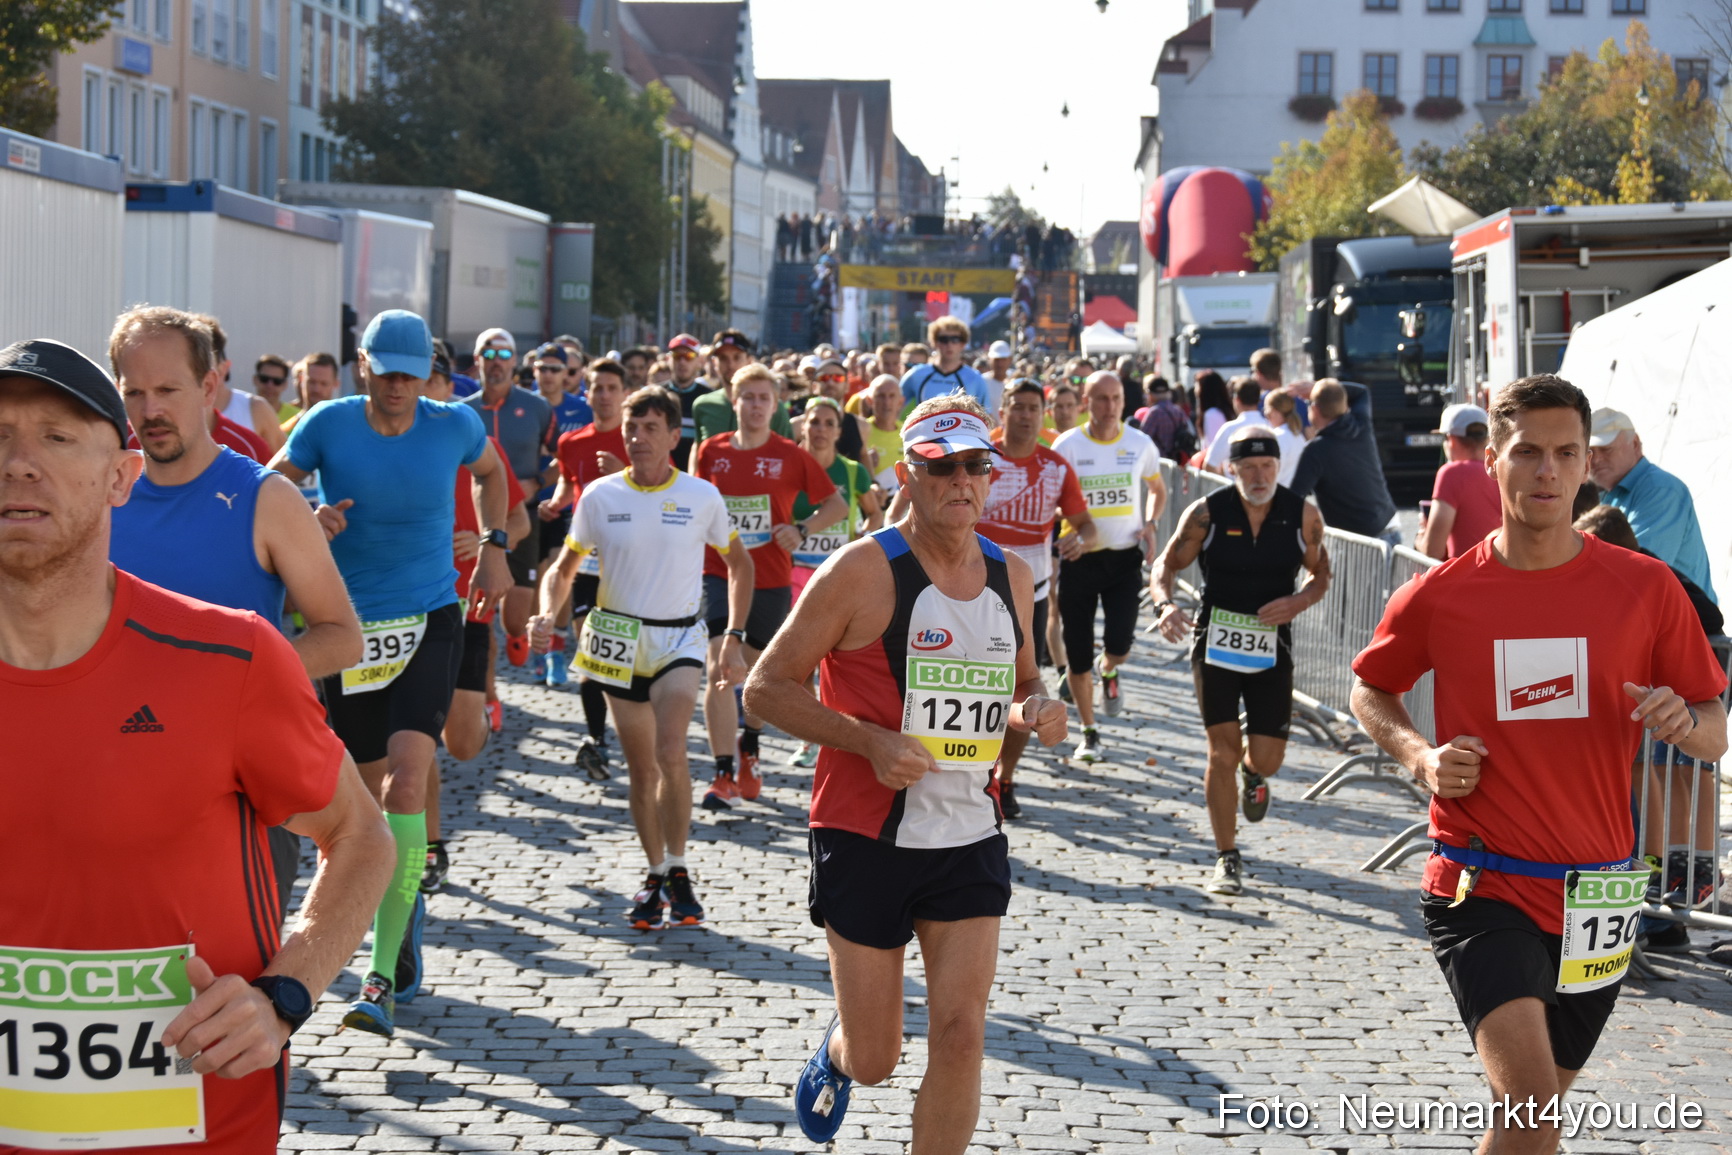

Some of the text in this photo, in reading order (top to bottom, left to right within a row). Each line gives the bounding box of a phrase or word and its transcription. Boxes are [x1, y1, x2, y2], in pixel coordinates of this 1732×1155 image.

[896, 271, 957, 286] START
[935, 419, 954, 429] tkn
[1083, 475, 1126, 488] BOCK
[1086, 489, 1128, 506] 1395
[661, 502, 677, 513] 20
[728, 513, 762, 531] 247
[799, 536, 842, 552] 2704
[1217, 611, 1270, 628] BOC
[916, 629, 945, 643] tkn
[1215, 628, 1269, 653] 2834
[360, 631, 417, 664] 393
[584, 631, 627, 663] 1052
[919, 665, 1008, 690] BOCK
[1527, 684, 1556, 701] DEHN
[921, 697, 1002, 733] 1210
[120, 723, 165, 734] adidas
[944, 743, 977, 757] UDO
[0, 1018, 172, 1081] 1364
